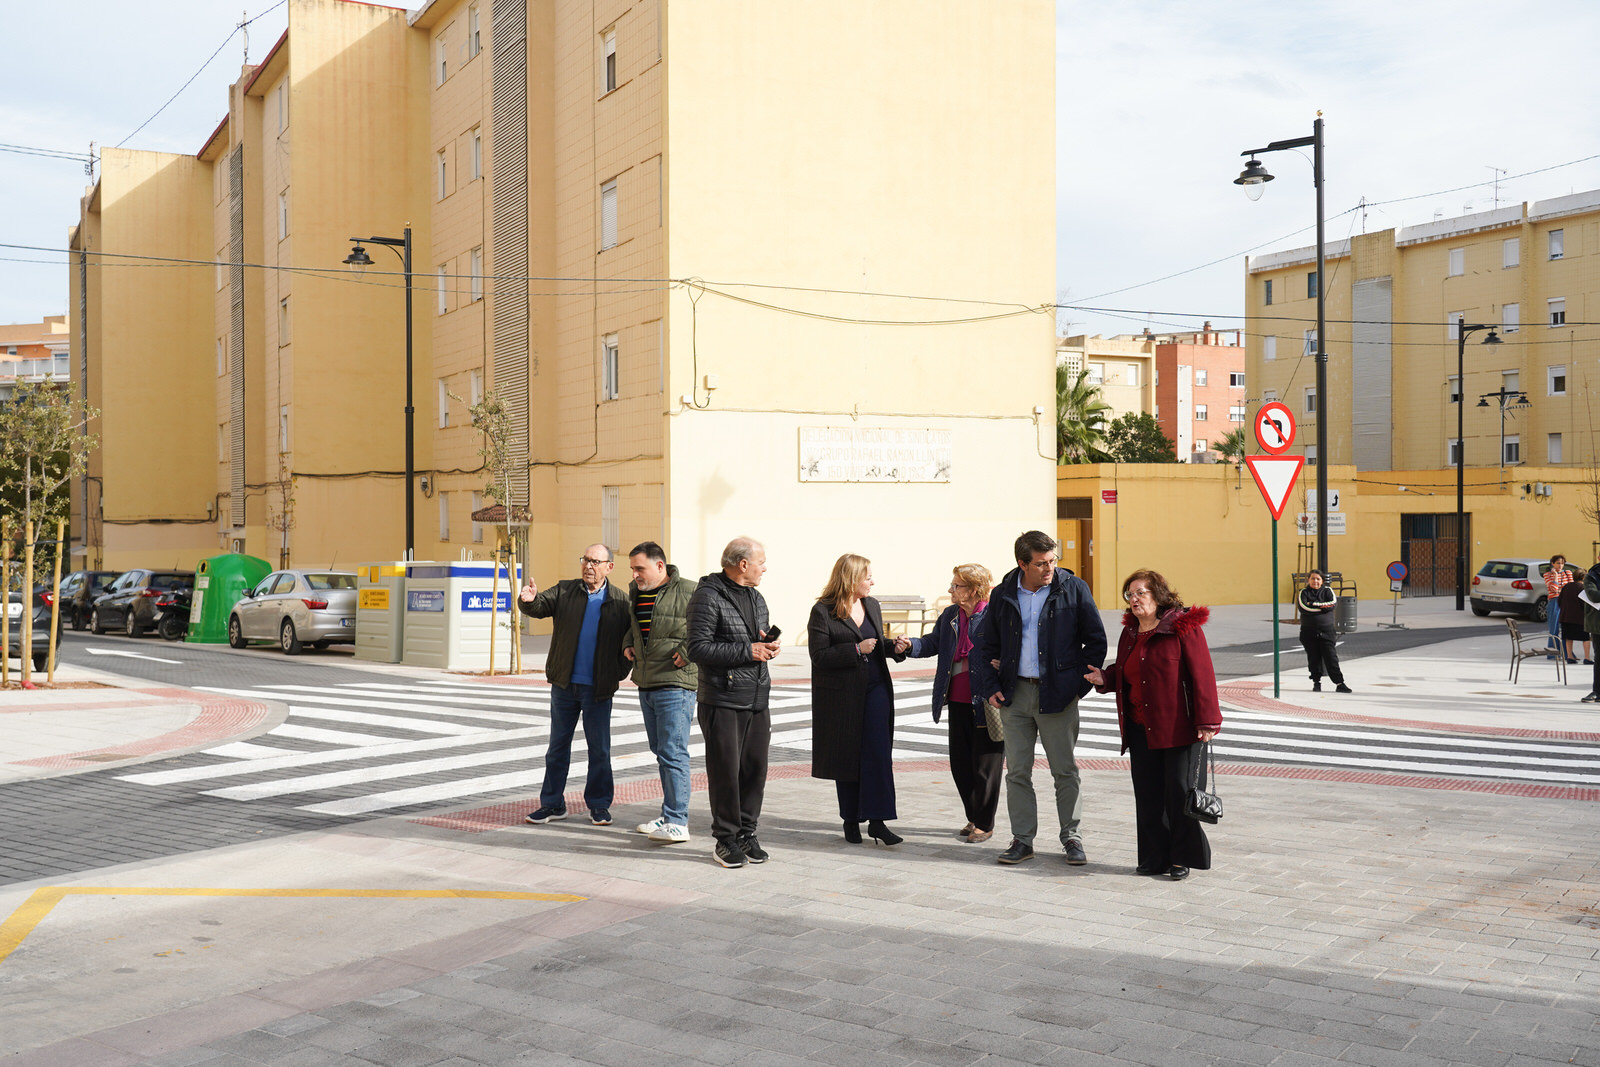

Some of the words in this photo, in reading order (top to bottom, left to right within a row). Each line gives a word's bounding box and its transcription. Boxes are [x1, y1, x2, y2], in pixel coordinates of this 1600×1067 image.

[895, 430, 905, 444] DE
[820, 447, 849, 461] GRUPO
[851, 447, 884, 462] RAFAEL
[887, 447, 915, 462] RAMON
